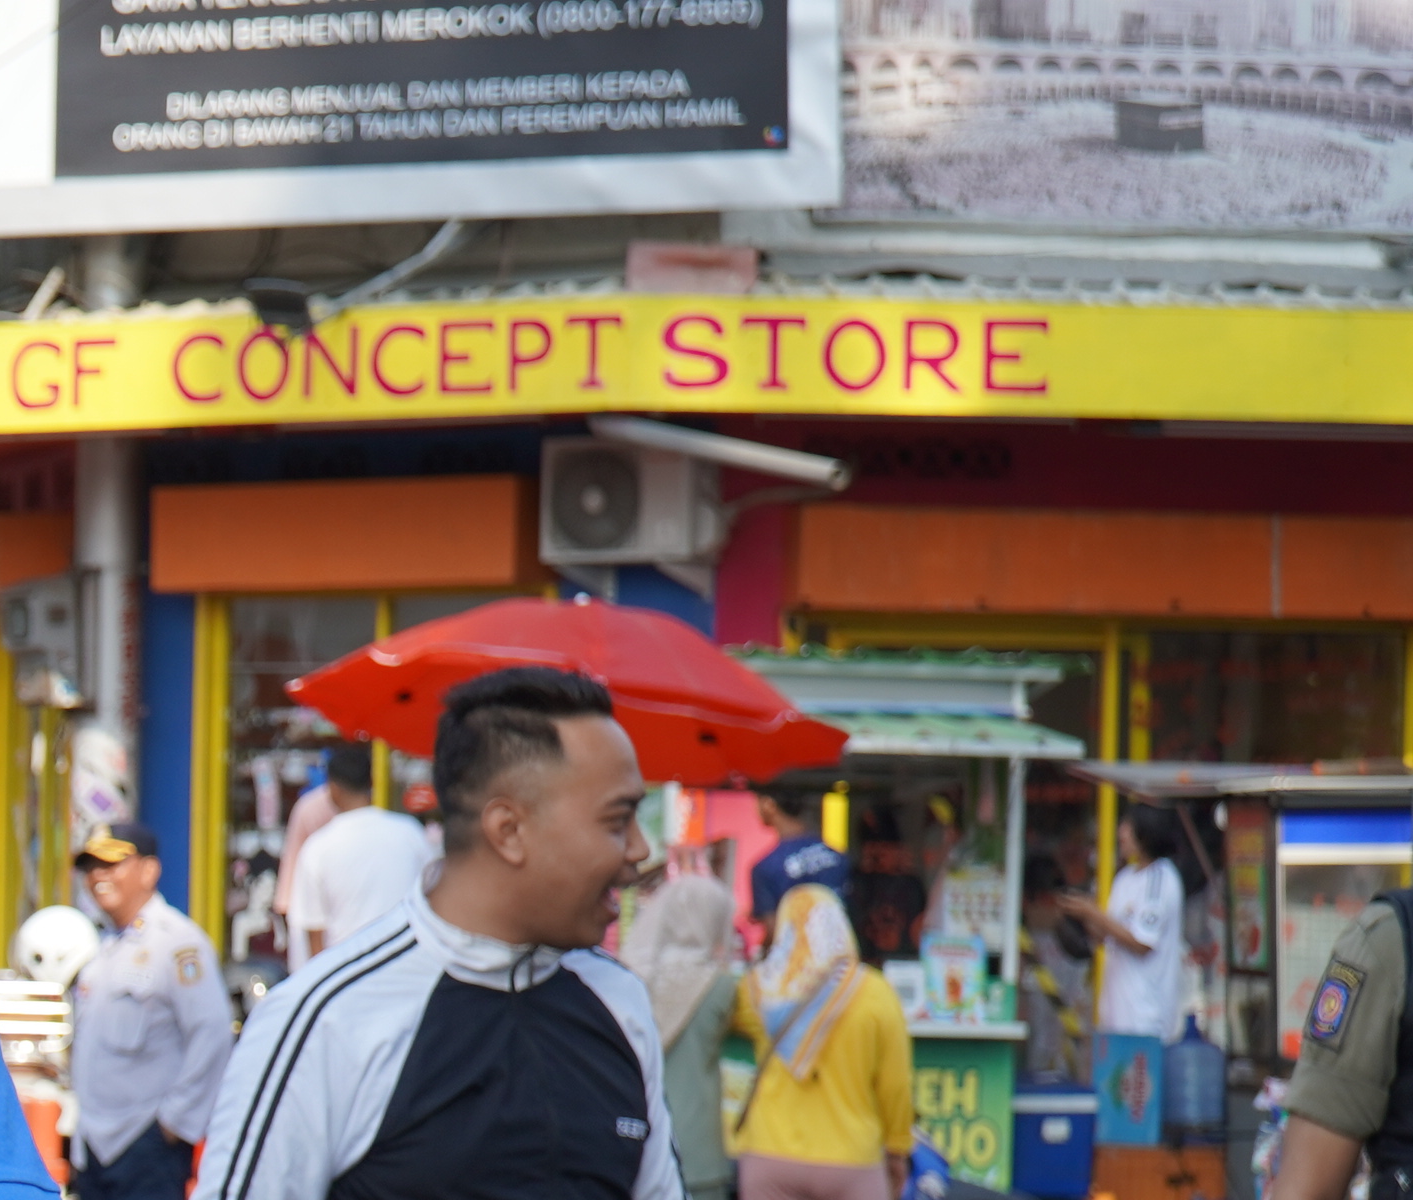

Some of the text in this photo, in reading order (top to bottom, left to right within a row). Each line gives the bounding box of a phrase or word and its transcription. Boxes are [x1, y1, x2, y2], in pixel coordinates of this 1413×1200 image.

[100, 18, 231, 56] LAYANAN
[233, 10, 379, 50] BERHENTI
[381, 3, 536, 42] MEROKOK
[166, 69, 691, 120] DILARANG MENJUAL DAN MEMBERI KEPADA
[112, 97, 747, 152] ORANG DI BAWAH 21 TAHUN DAN PEREMPUAN HAMIL
[12, 313, 1050, 409] GF CONCEPT STORE
